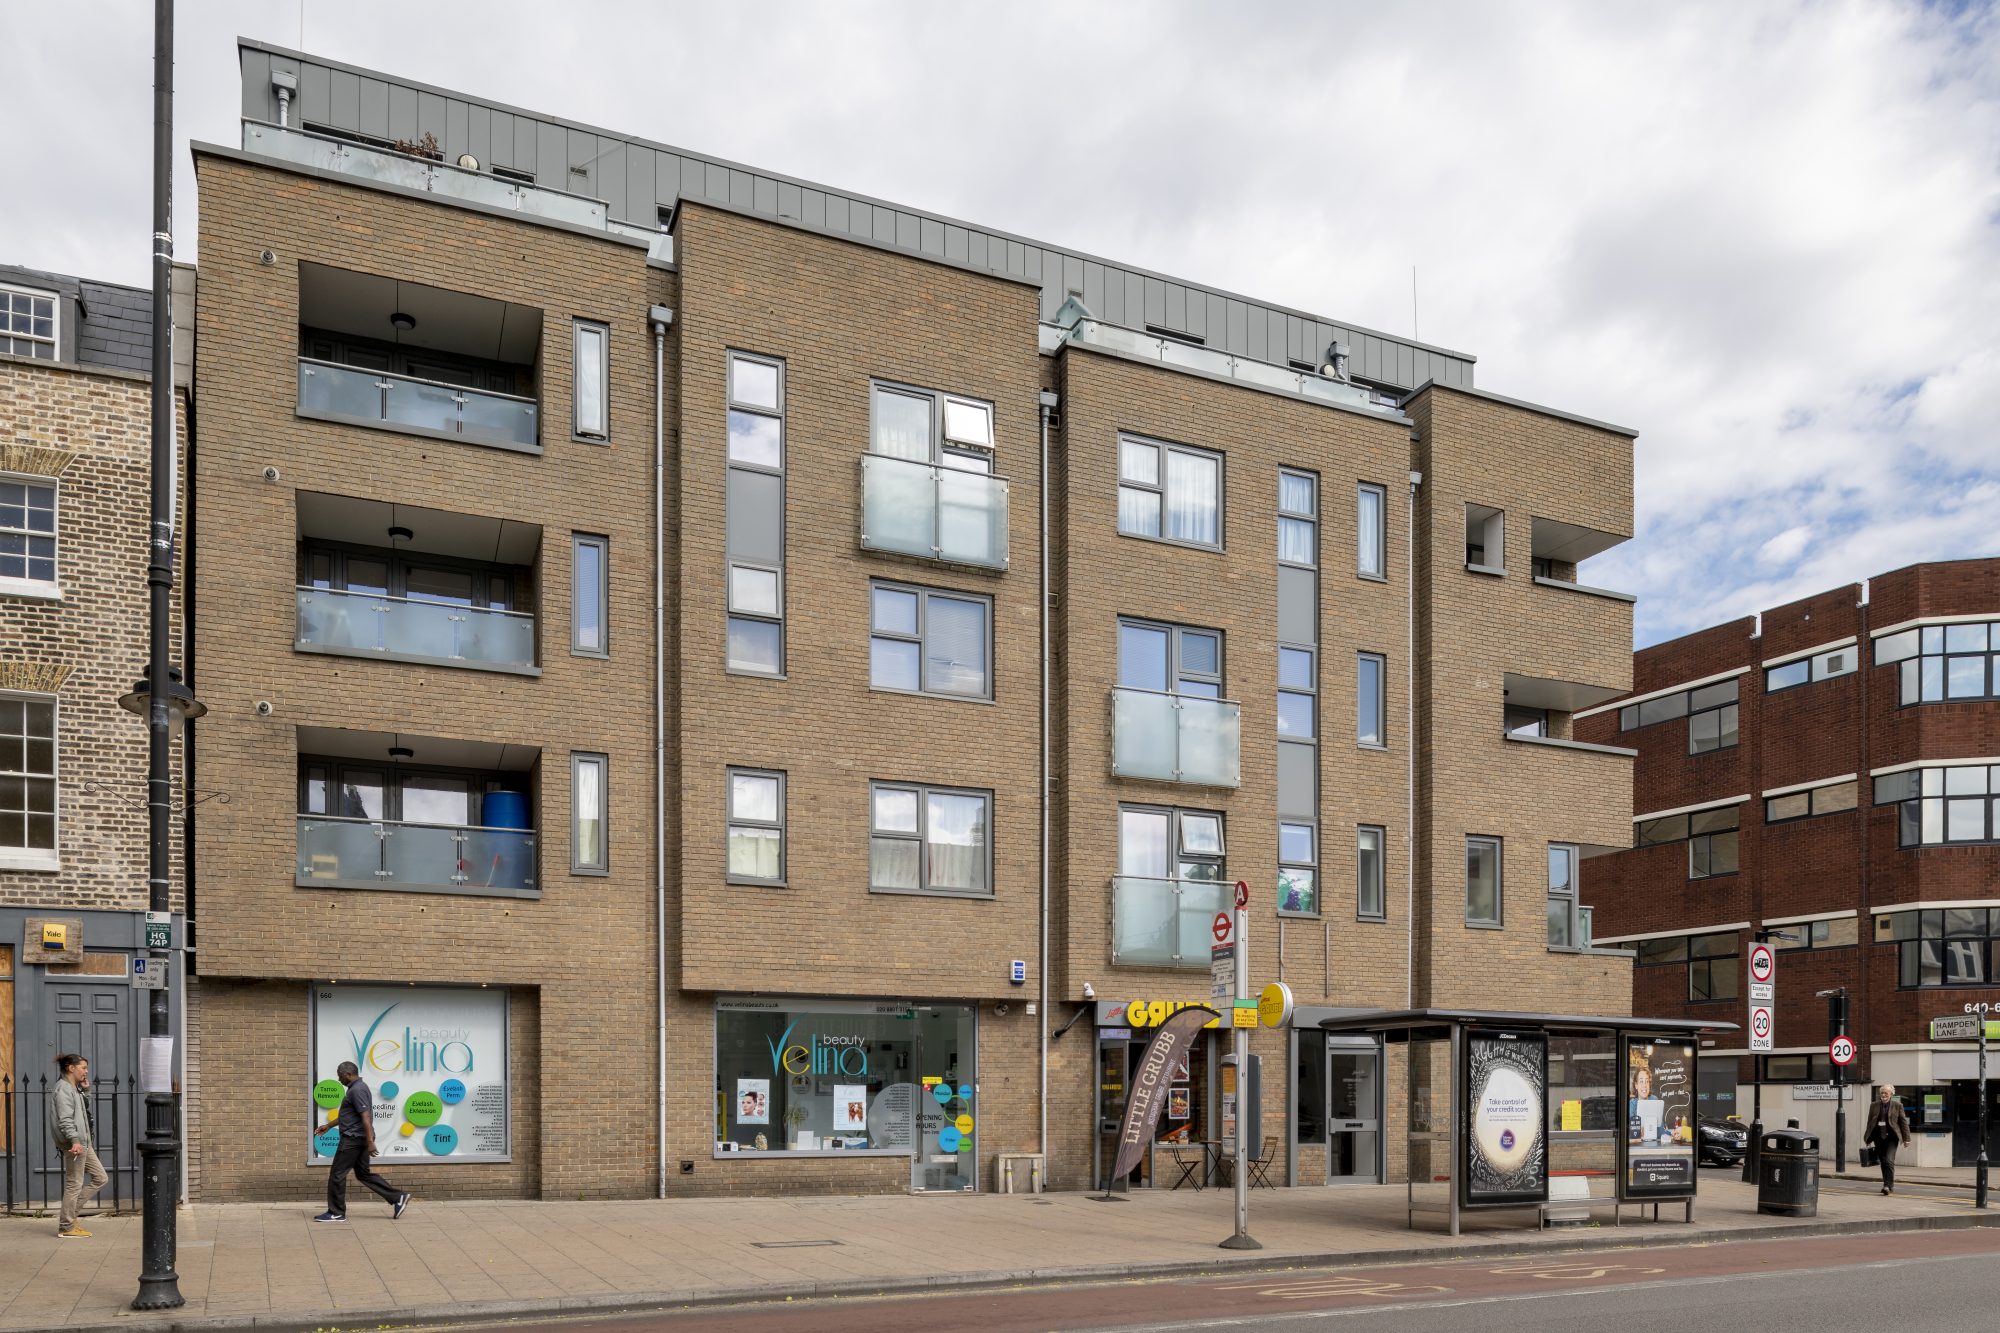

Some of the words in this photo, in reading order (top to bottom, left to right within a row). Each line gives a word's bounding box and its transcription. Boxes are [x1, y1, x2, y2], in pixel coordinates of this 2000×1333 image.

[1236, 884, 1245, 903] A
[46, 930, 61, 938] Yale
[151, 932, 166, 940] HG
[149, 939, 168, 947] 74P
[1756, 1018, 1768, 1029] 20
[1936, 1020, 1976, 1030] HAMPDEN
[348, 1001, 473, 1072] Velina
[419, 1026, 471, 1042] beauty
[1936, 1029, 1958, 1037] LANE
[766, 1011, 868, 1078] Velina
[823, 1034, 865, 1048] beauty
[1753, 1040, 1770, 1048] ZONE
[1834, 1045, 1851, 1056] 20
[1125, 1087, 1152, 1144] LITTLE
[1142, 1031, 1176, 1086] GRUBB
[372, 1103, 396, 1111] eedling
[433, 1133, 451, 1143] Tint
